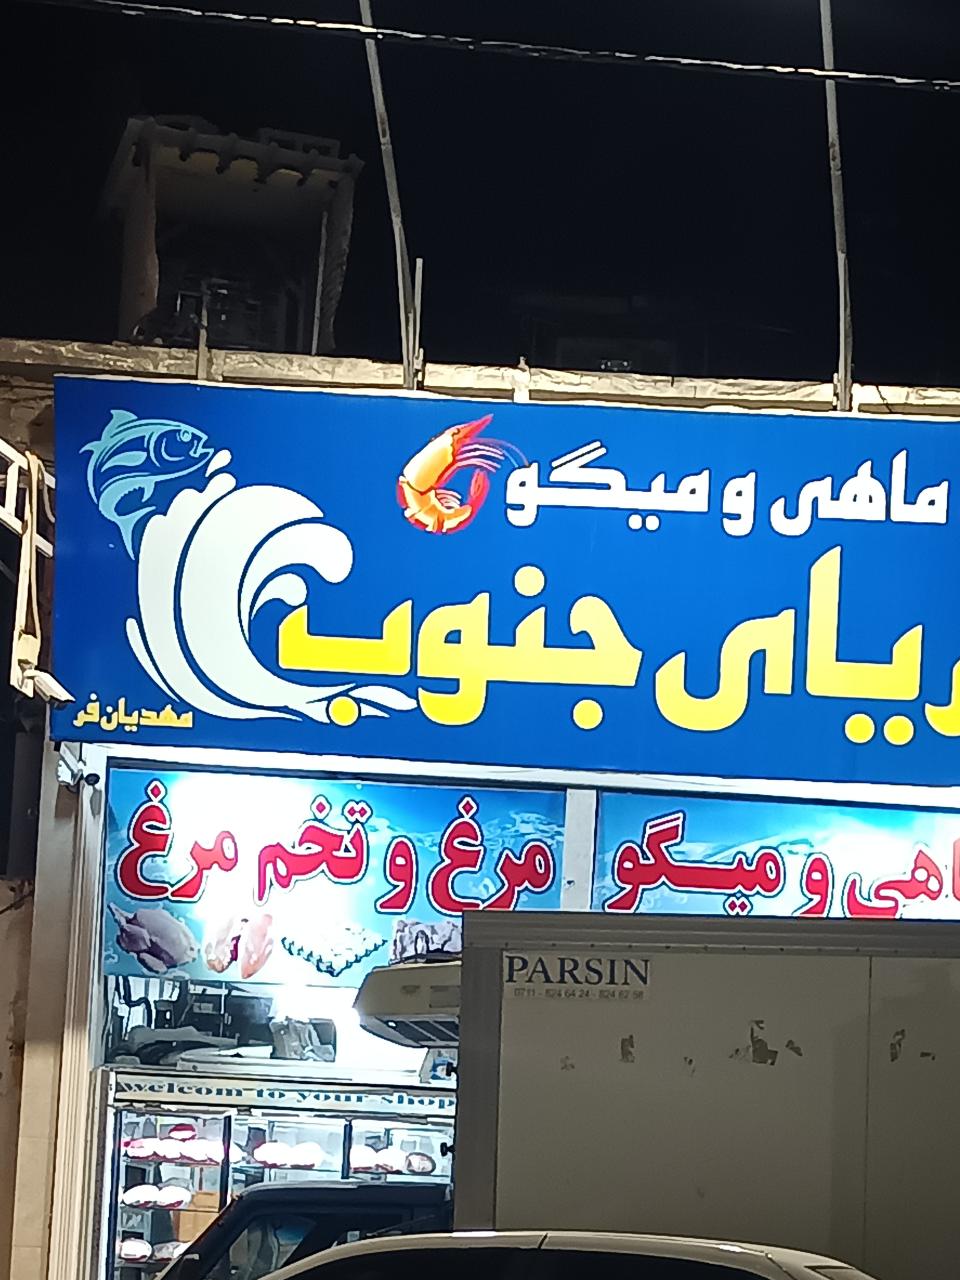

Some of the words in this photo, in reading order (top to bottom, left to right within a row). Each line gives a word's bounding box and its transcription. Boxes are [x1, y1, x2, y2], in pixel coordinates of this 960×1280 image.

[505, 440, 710, 531] میگو
[722, 471, 757, 537] و
[769, 449, 949, 537] ماهی
[278, 565, 643, 730] جنوب
[116, 782, 238, 902] مرغ
[255, 796, 368, 903] تخم
[377, 838, 417, 912] و
[429, 797, 554, 913] مرغ
[605, 813, 786, 914] میگو
[797, 853, 832, 916] و
[505, 955, 650, 986] PARSIN
